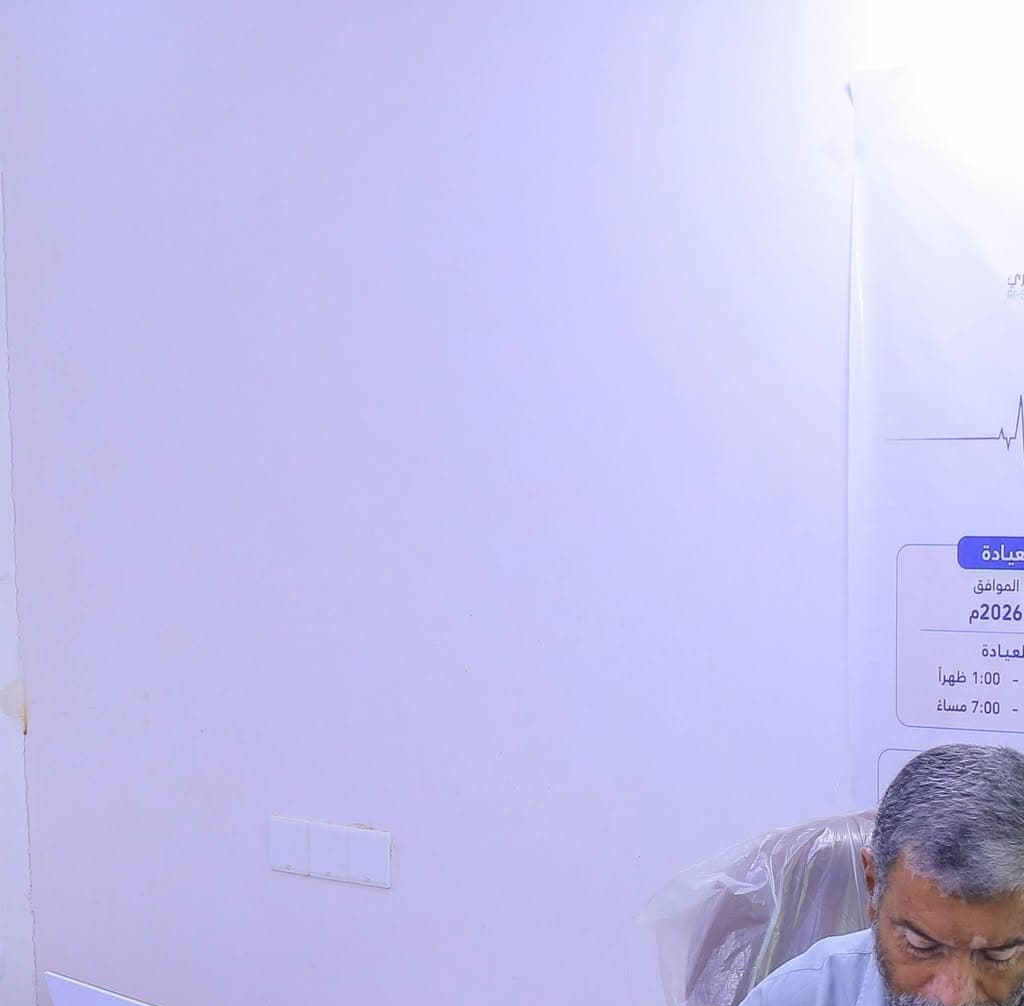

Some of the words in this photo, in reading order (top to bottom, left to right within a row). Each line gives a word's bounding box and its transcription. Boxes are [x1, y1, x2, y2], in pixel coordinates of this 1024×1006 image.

[973, 579, 1020, 595] الموافق
[968, 603, 1023, 624] 2026م
[972, 671, 1001, 686] 1:00
[971, 700, 1001, 715] 7:00
